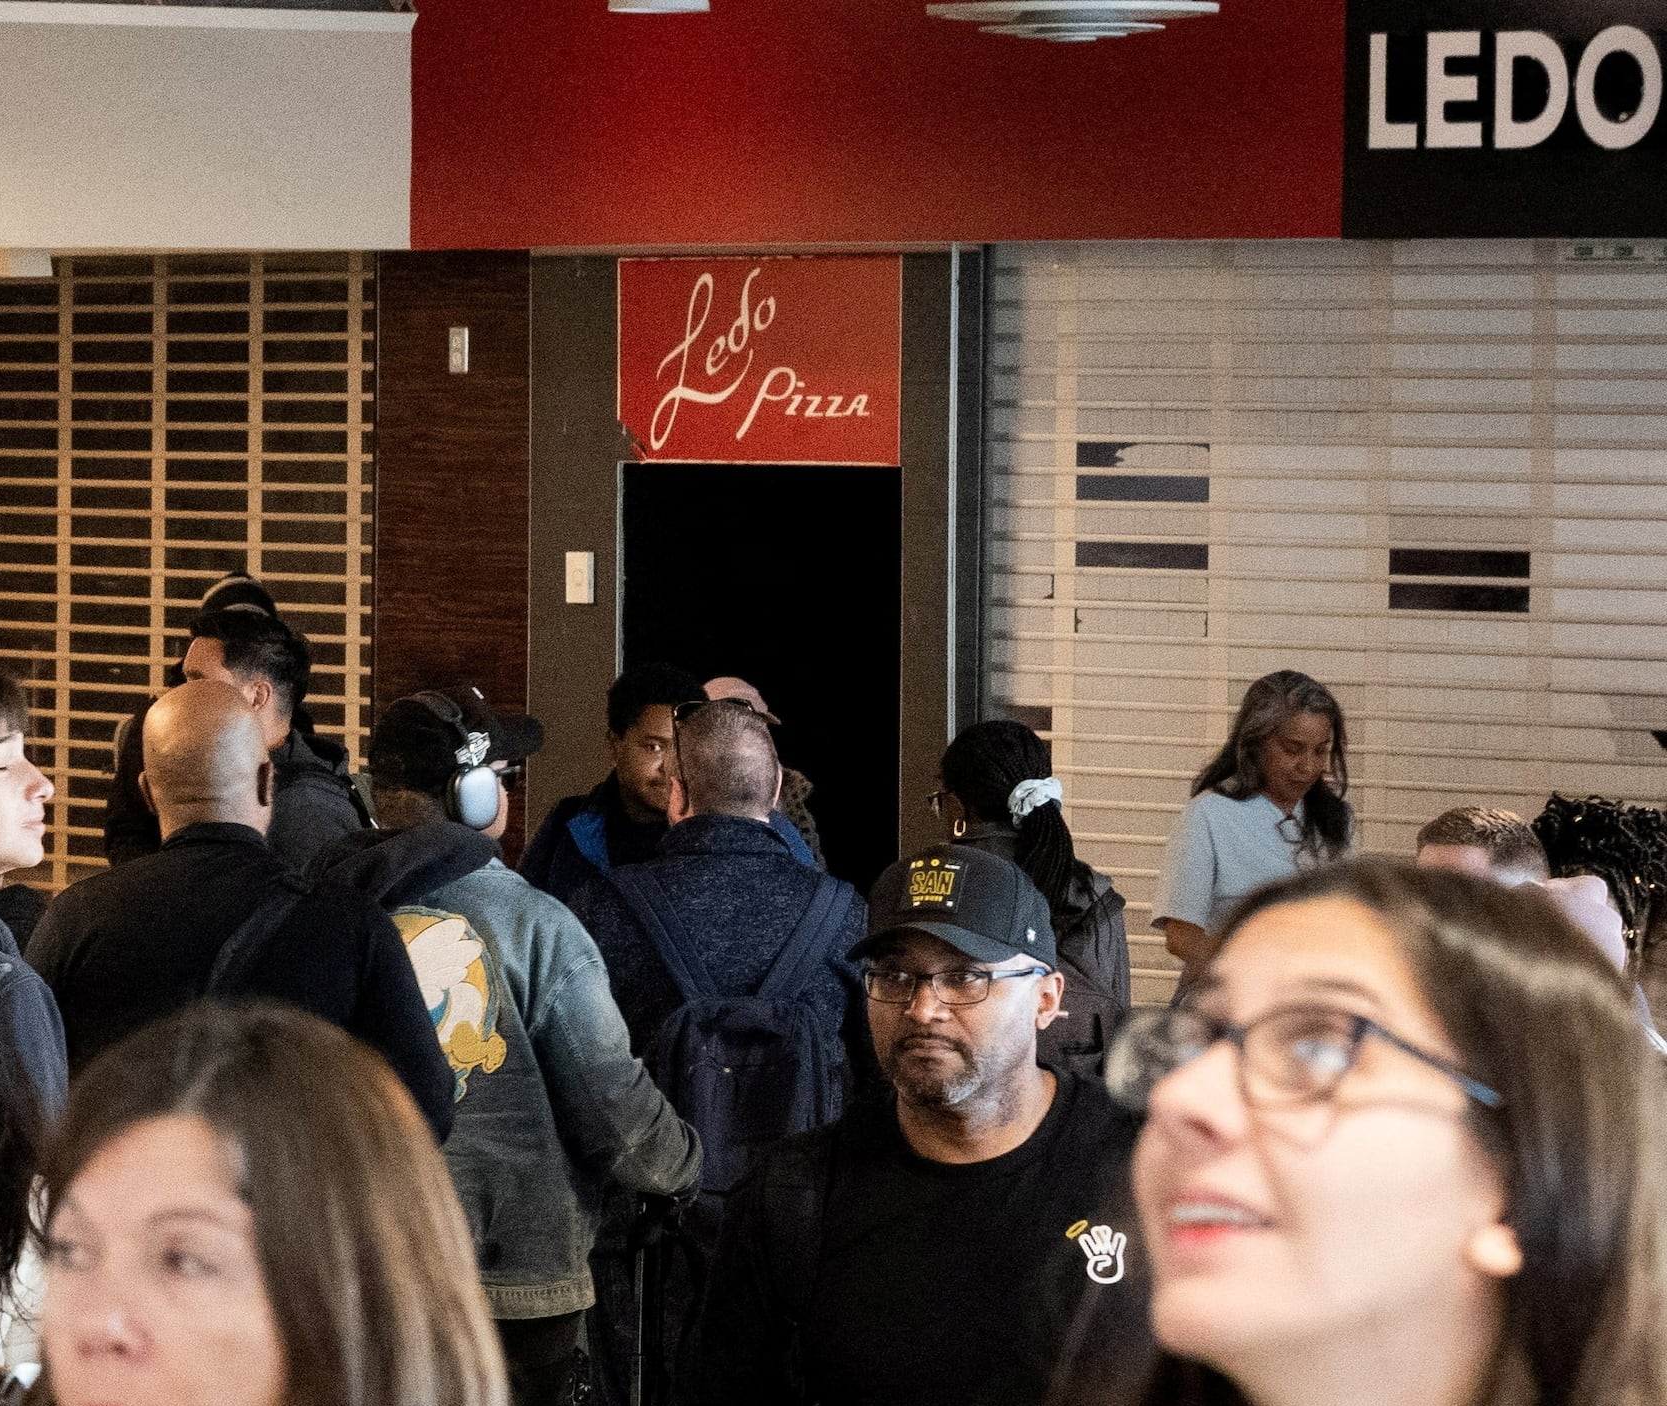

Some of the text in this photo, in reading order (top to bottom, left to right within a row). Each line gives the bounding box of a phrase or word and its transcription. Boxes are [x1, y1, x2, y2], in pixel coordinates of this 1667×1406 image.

[1368, 25, 1663, 149] LEDO
[650, 267, 776, 451] Ledo
[909, 870, 955, 895] SAN
